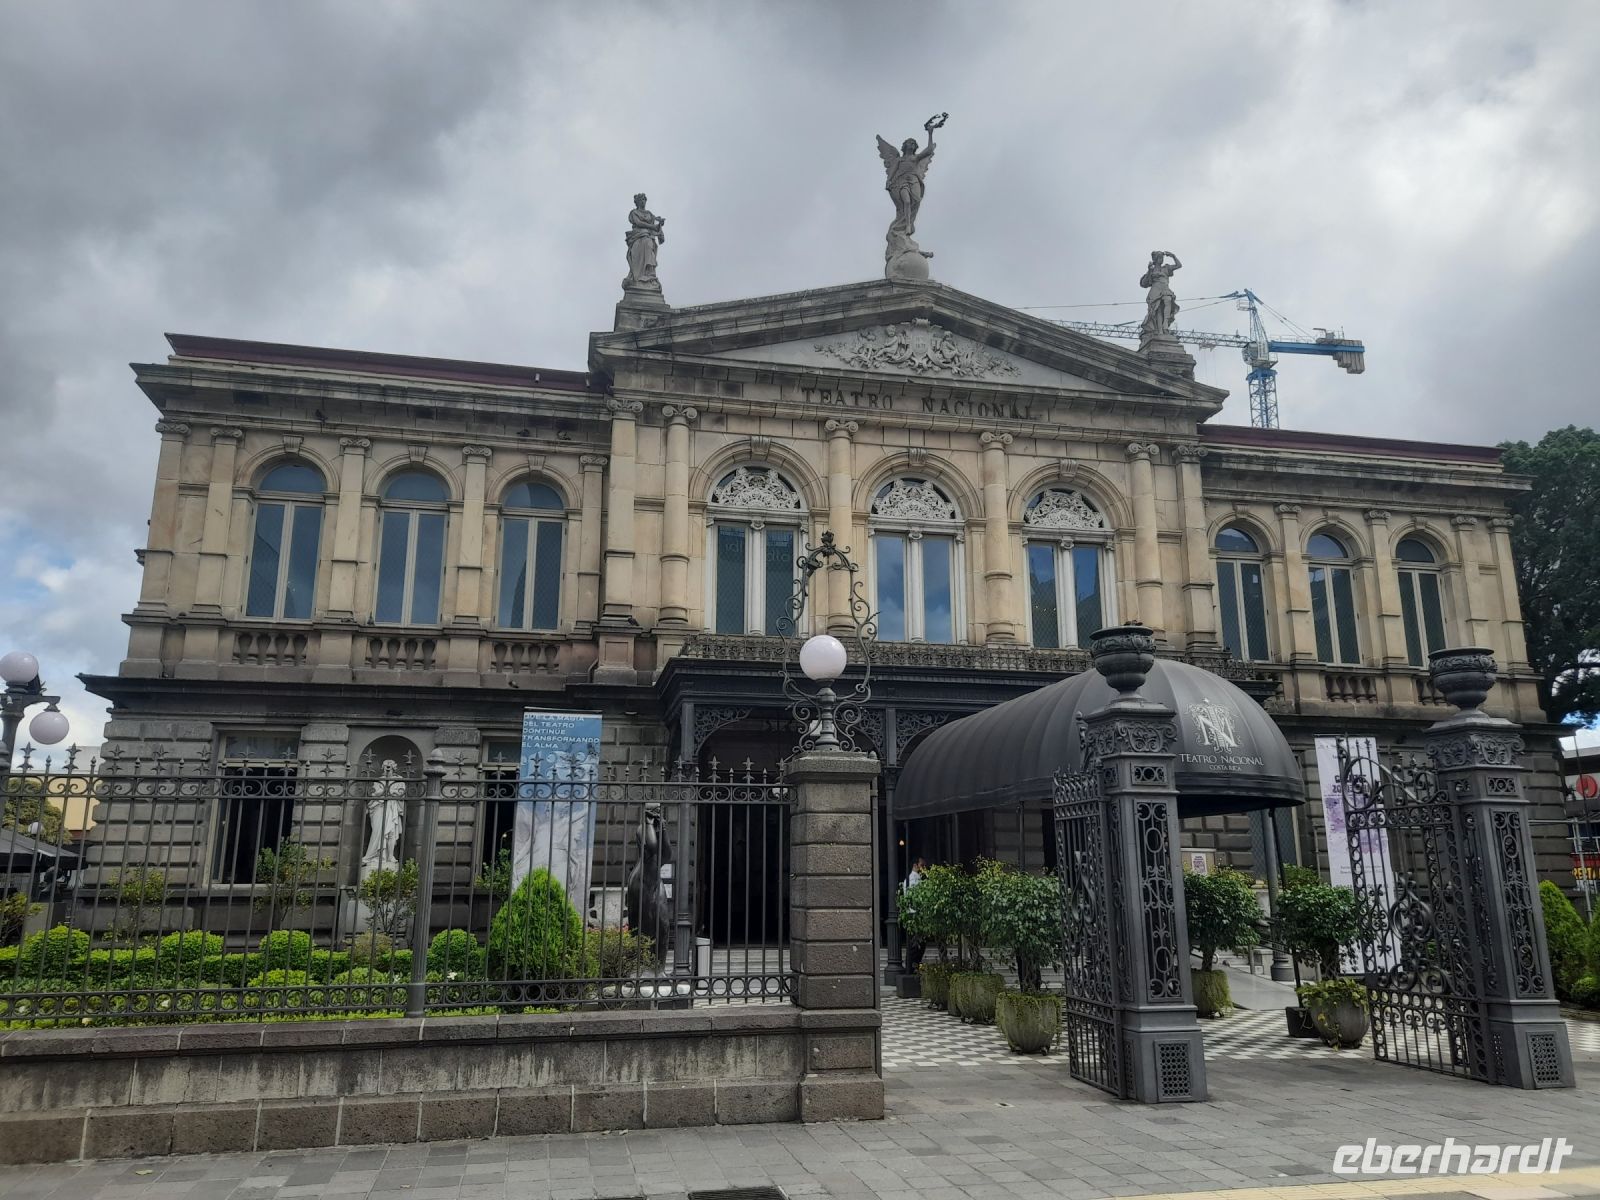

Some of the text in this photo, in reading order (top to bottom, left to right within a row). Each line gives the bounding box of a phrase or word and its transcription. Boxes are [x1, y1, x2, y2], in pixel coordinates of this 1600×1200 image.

[801, 387, 1035, 420] TEATRO NACIONAL
[541, 721, 575, 729] TEATRO
[522, 735, 600, 743] TRANSFORMANDO
[1179, 753, 1264, 766] TEATRO NACIONAL
